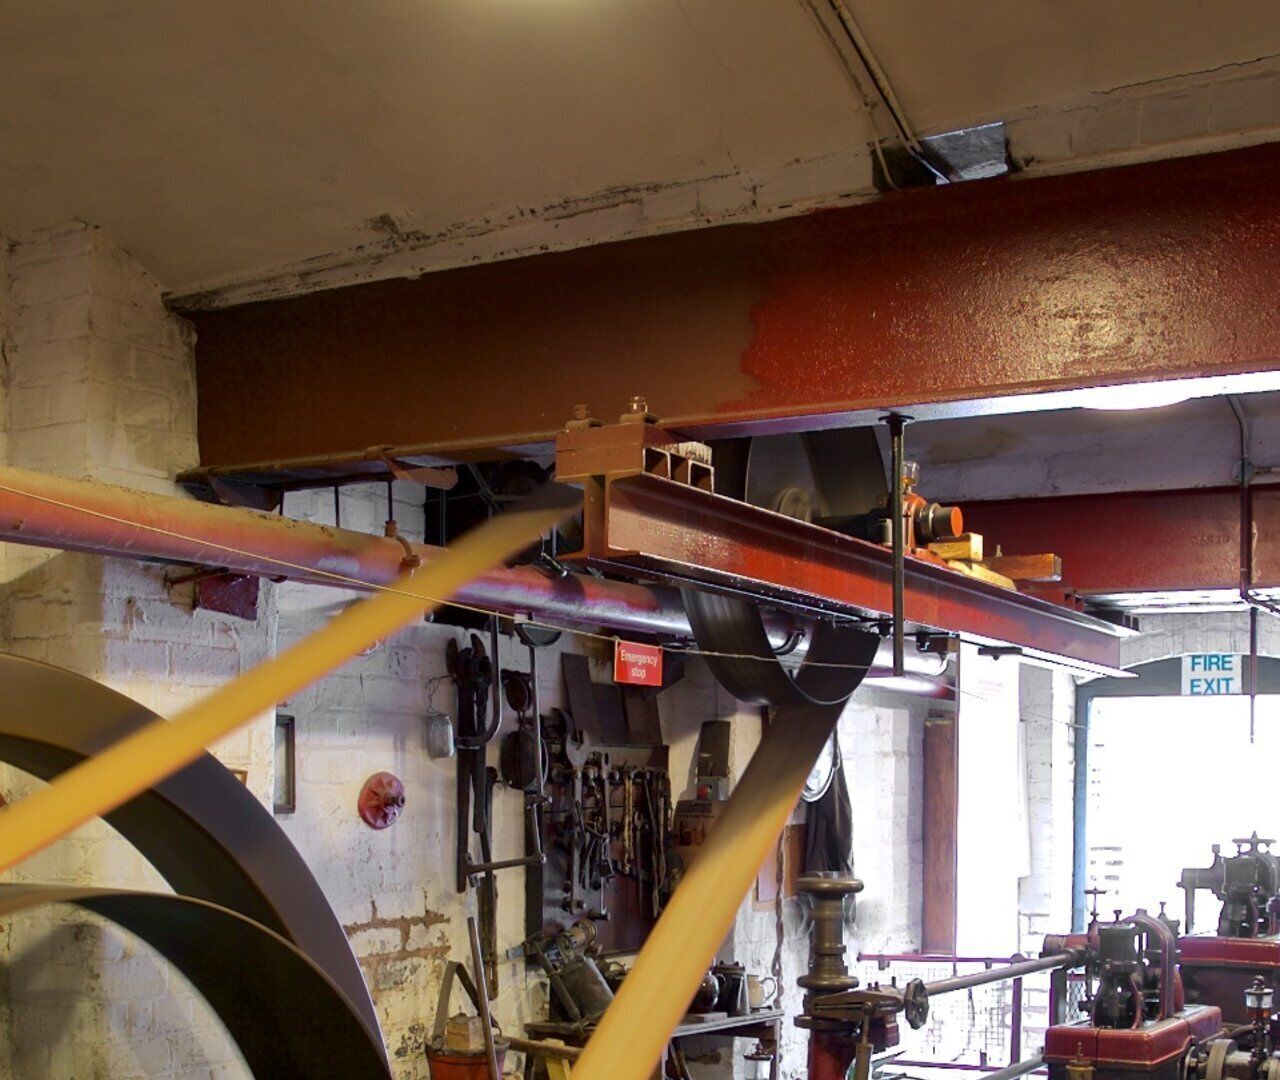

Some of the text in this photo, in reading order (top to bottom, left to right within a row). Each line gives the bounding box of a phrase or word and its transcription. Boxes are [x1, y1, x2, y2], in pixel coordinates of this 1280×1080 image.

[621, 650, 658, 668] Emergency
[1190, 654, 1234, 672] FIRE
[631, 667, 646, 680] stop
[1190, 677, 1234, 695] EXIT
